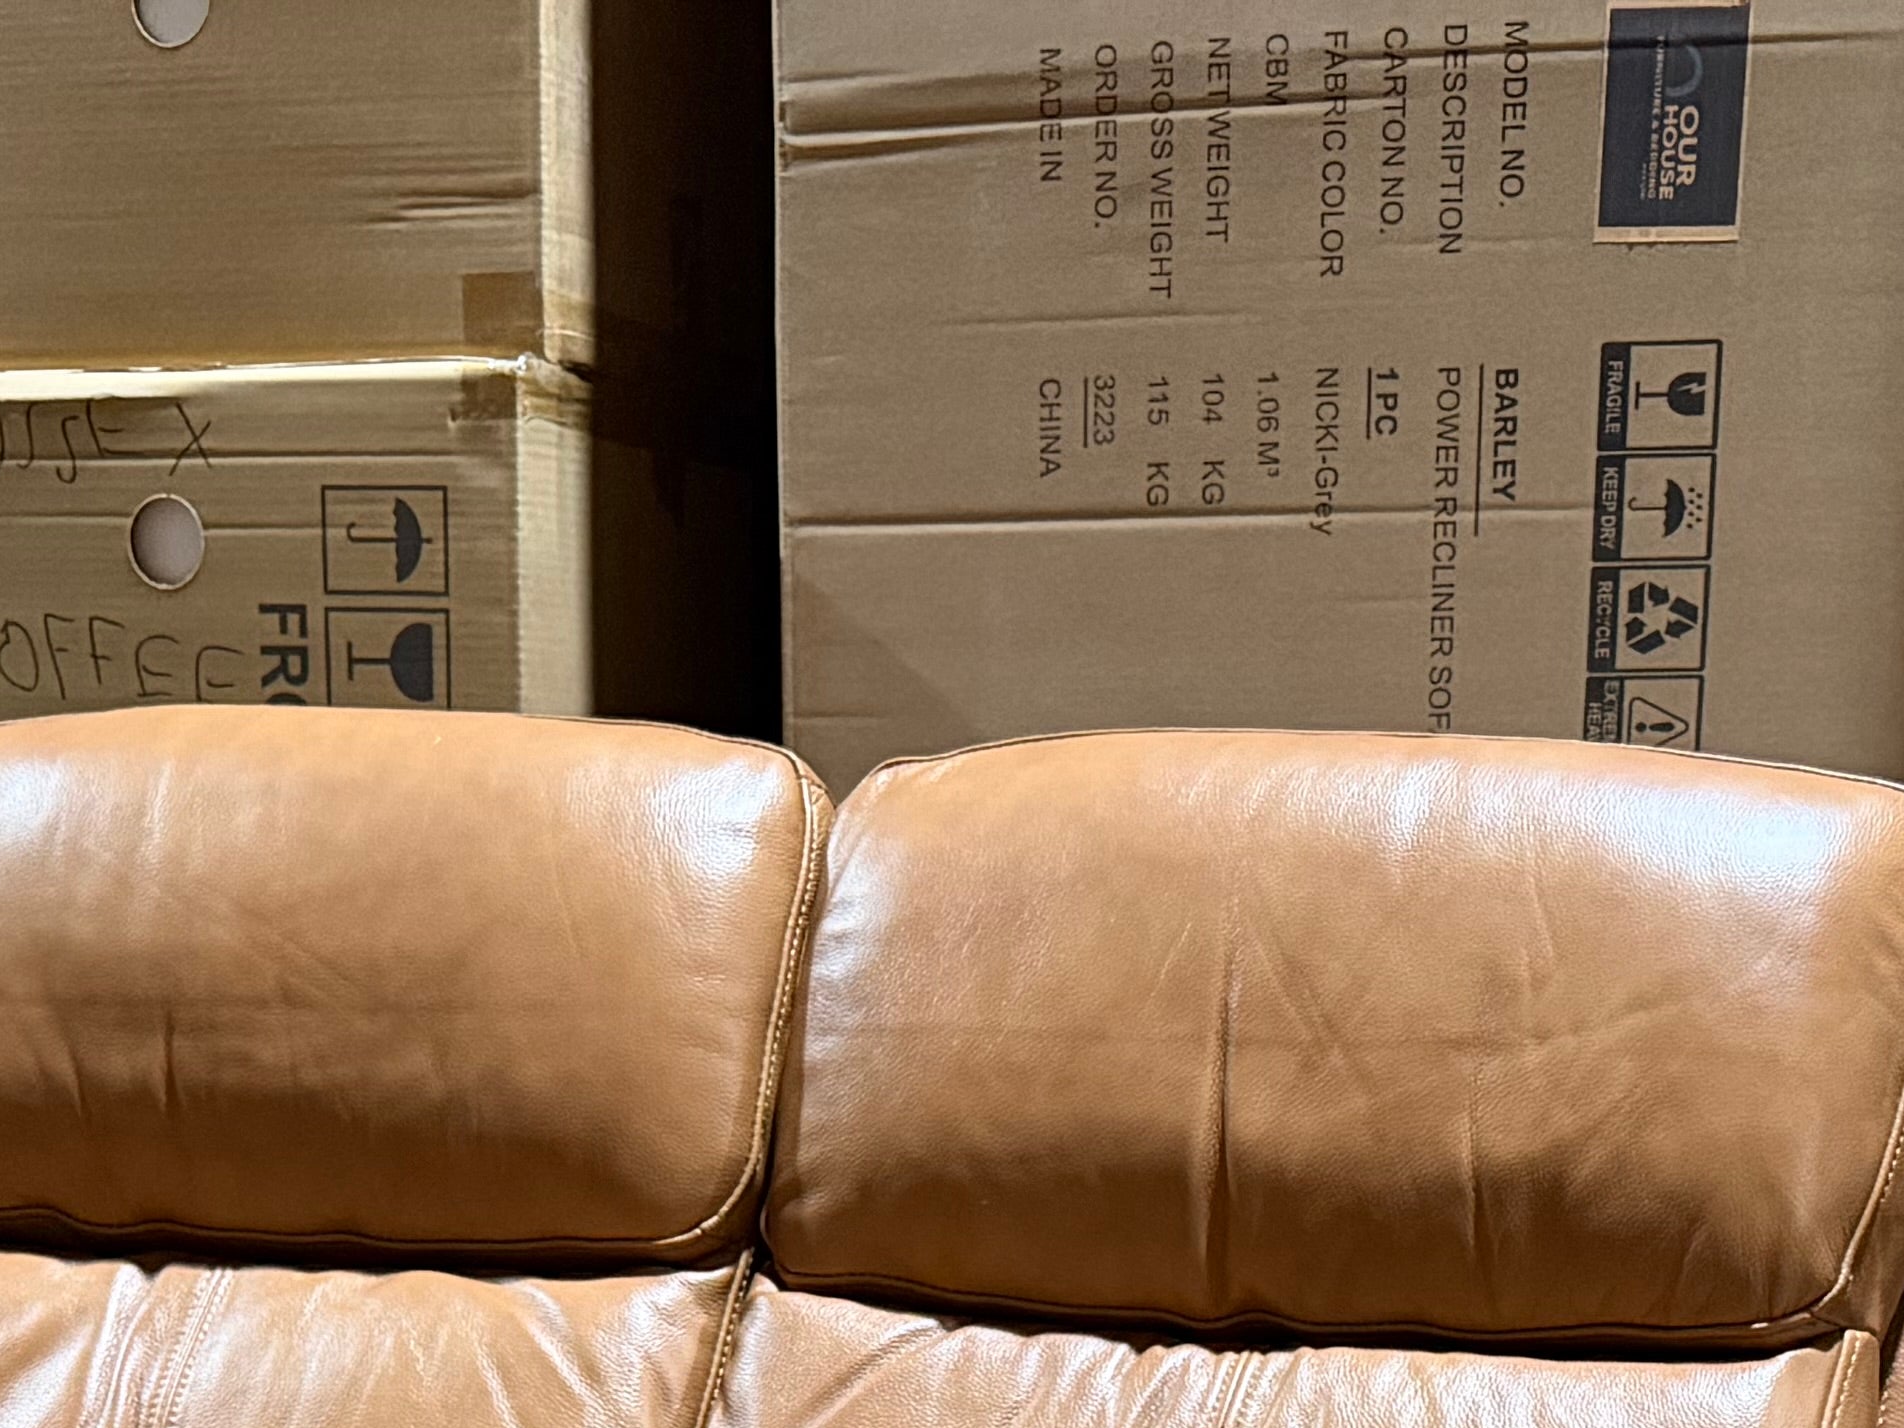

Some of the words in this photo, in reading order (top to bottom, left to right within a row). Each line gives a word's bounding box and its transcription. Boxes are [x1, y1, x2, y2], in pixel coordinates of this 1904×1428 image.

[1040, 48, 1062, 142] MADE
[1095, 44, 1118, 163] ORDER
[1151, 41, 1174, 160] GROSS
[1208, 37, 1231, 103] NET
[1265, 33, 1290, 105] CBM
[1323, 31, 1348, 151] FABRIC
[1382, 27, 1408, 166] CARTON
[1501, 21, 1529, 143] MODEL
[1040, 151, 1063, 182] IN
[1439, 24, 1468, 254] DESCRIPTION
[1658, 104, 1679, 200] HOUSE
[1676, 105, 1699, 186] OUR
[1094, 171, 1117, 228] NO.
[1206, 111, 1231, 242] WEIGHT
[1380, 177, 1405, 234] NO.
[1499, 149, 1525, 207] NO.
[1149, 167, 1173, 298] WEIGHT
[1320, 161, 1346, 277] COLOR
[1093, 374, 1116, 447] 3223
[1147, 375, 1169, 426] 115
[1201, 373, 1224, 425] 104
[1256, 371, 1280, 433] 1.06
[1376, 367, 1399, 382] 1
[1604, 359, 1624, 433] FRAGILE
[1039, 378, 1062, 478] CHINA
[1374, 392, 1399, 436] PC
[1434, 367, 1461, 489] POWER
[1492, 368, 1519, 502] BARLEY
[1146, 461, 1169, 507] KG
[1201, 460, 1224, 506] KG
[1310, 367, 1339, 536] NICKI-Grey
[1601, 466, 1619, 516] KEEP
[1599, 518, 1617, 549] DRY
[1429, 496, 1457, 658] RECLINER
[1594, 581, 1613, 659] RECYCLE
[1428, 666, 1453, 733] SOF
[1587, 702, 1603, 741] HEA
[1603, 680, 1620, 741] EXTRE
